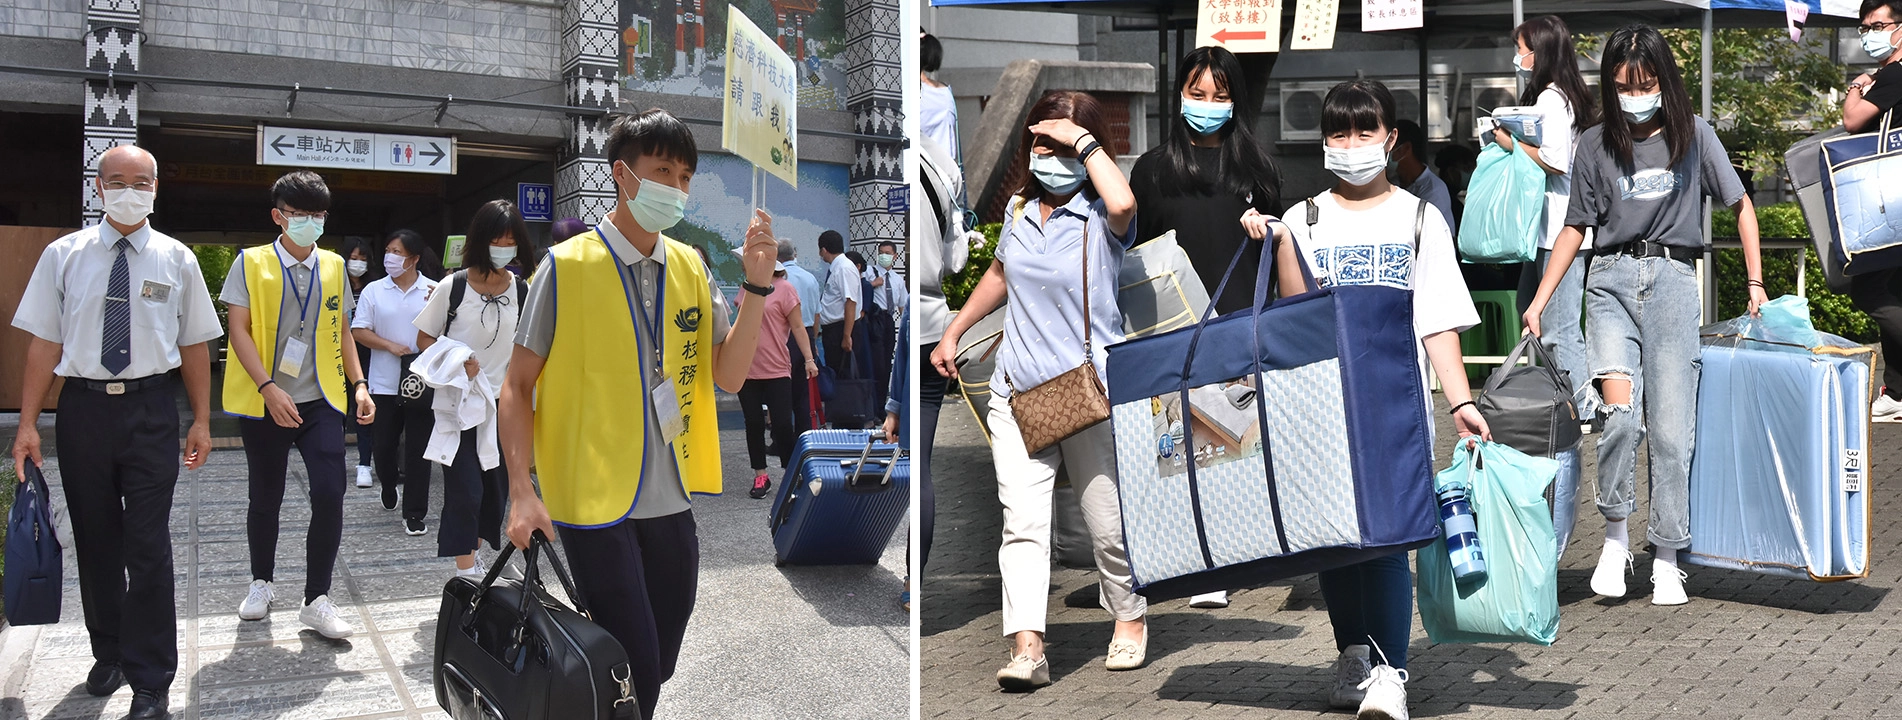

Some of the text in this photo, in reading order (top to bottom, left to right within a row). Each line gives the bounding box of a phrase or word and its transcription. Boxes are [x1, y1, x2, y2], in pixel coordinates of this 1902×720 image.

[296, 134, 370, 156] 車站大廳
[1616, 172, 1684, 198] Deeps
